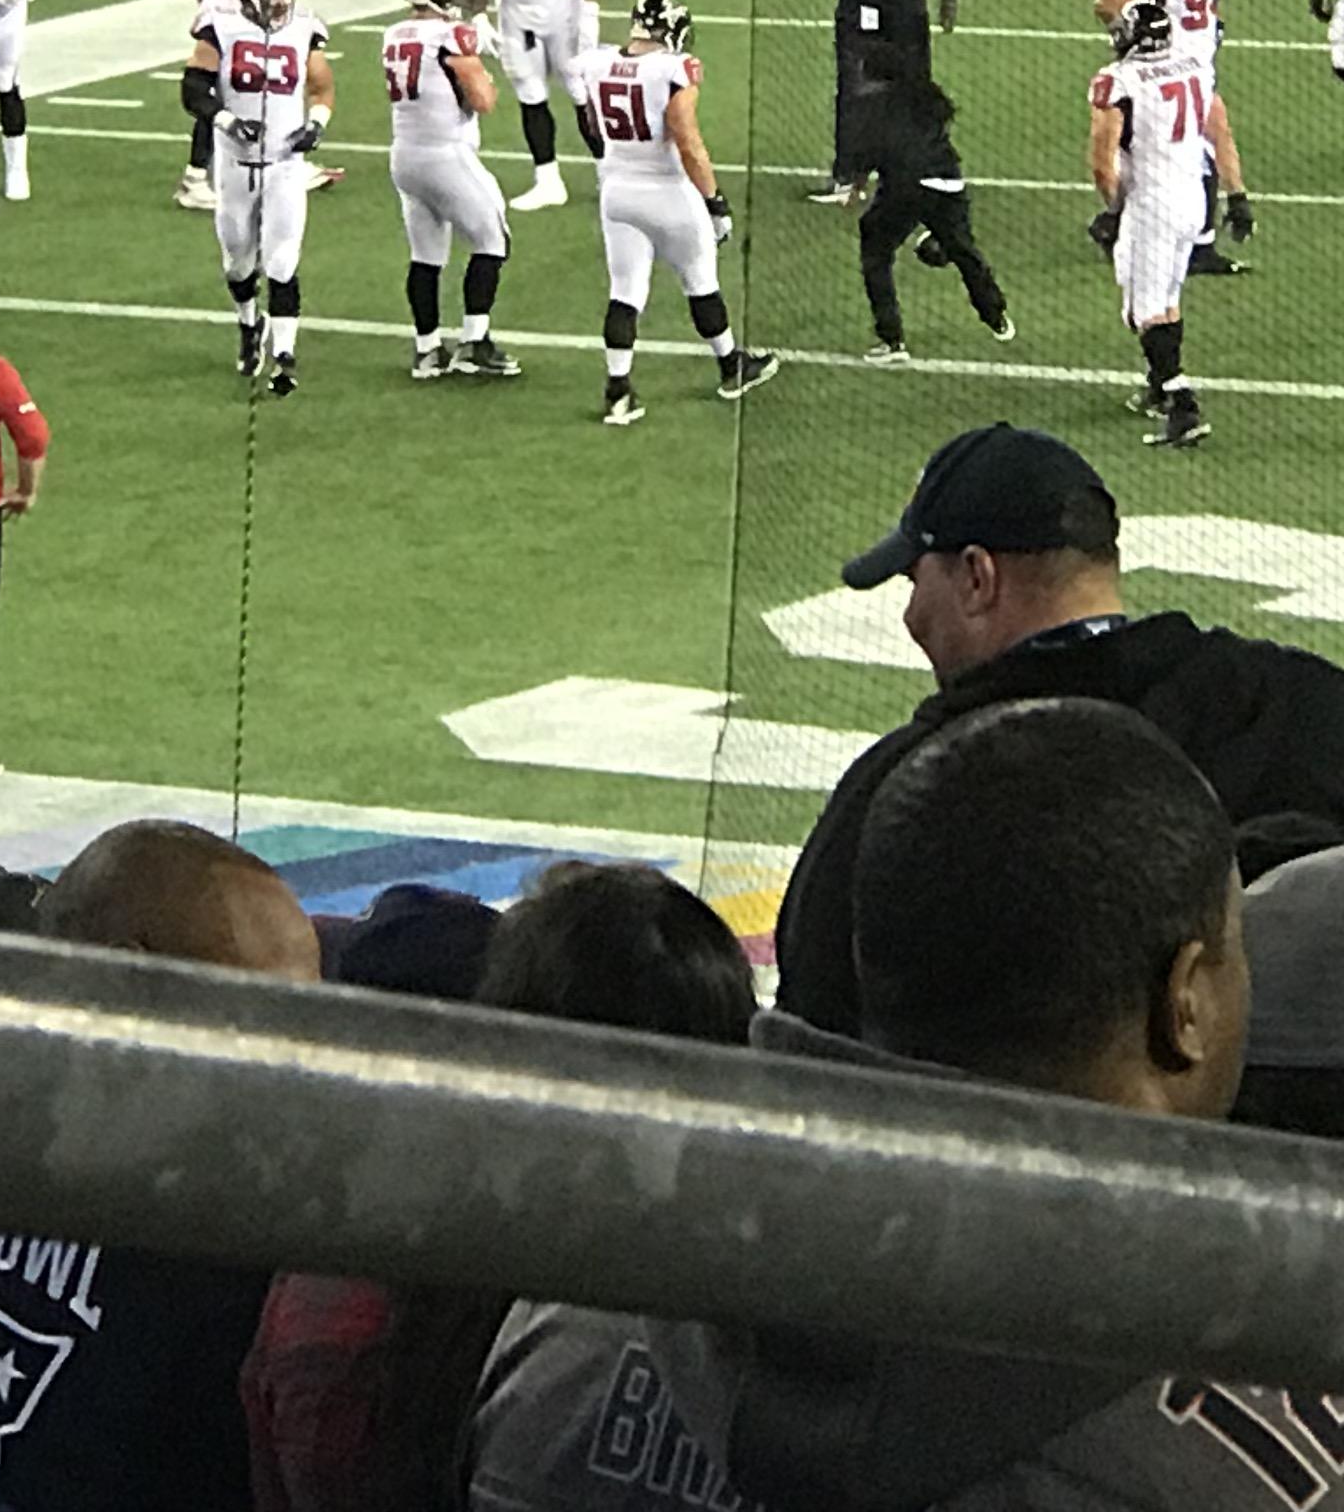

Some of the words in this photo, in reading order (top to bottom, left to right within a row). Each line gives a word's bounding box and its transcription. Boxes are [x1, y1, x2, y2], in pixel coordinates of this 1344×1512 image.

[230, 39, 300, 96] 63
[598, 81, 653, 143] 51
[1159, 75, 1206, 143] 71
